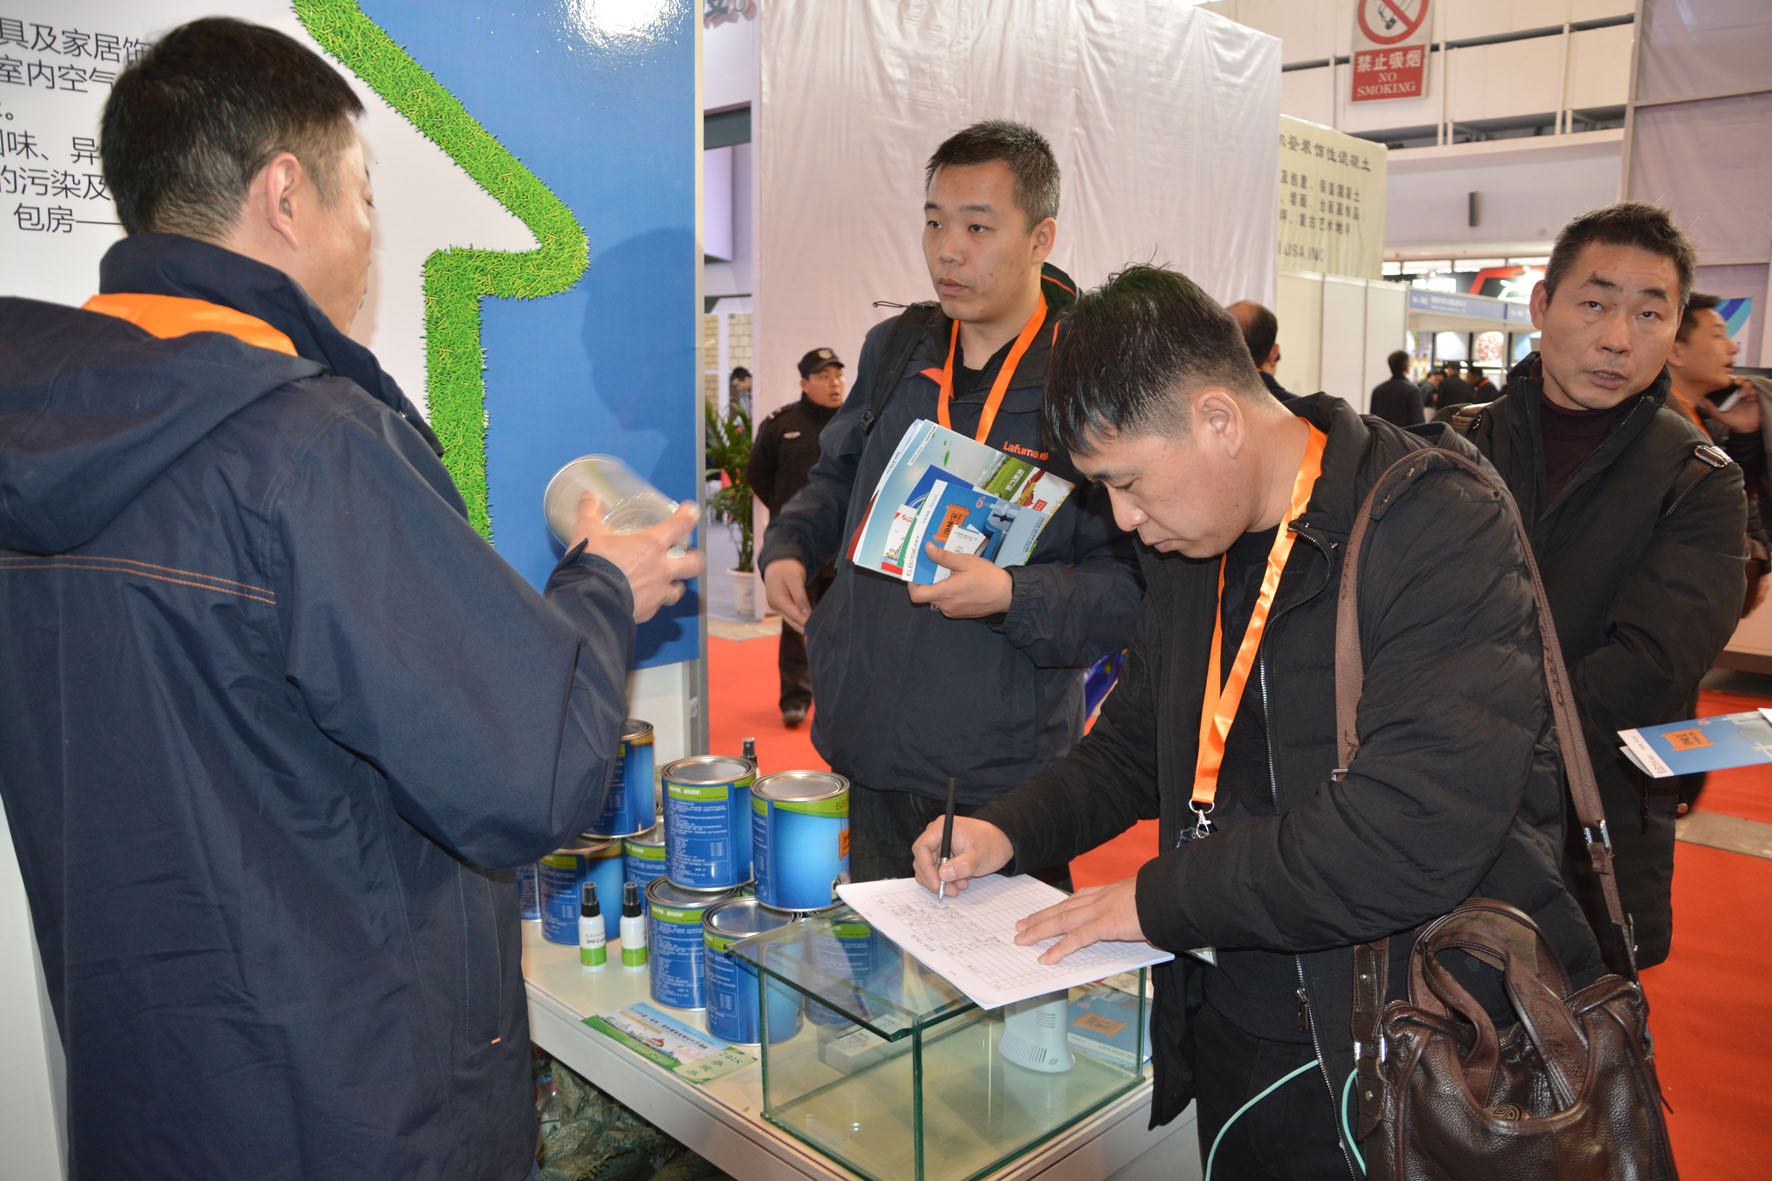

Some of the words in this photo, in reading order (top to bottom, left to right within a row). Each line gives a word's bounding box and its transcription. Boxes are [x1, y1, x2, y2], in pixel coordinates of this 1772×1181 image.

[1357, 49, 1422, 73] 禁止吸烟
[1378, 72, 1397, 83] NO
[1357, 81, 1416, 97] SMOKING
[1003, 440, 1039, 459] Lafuma
